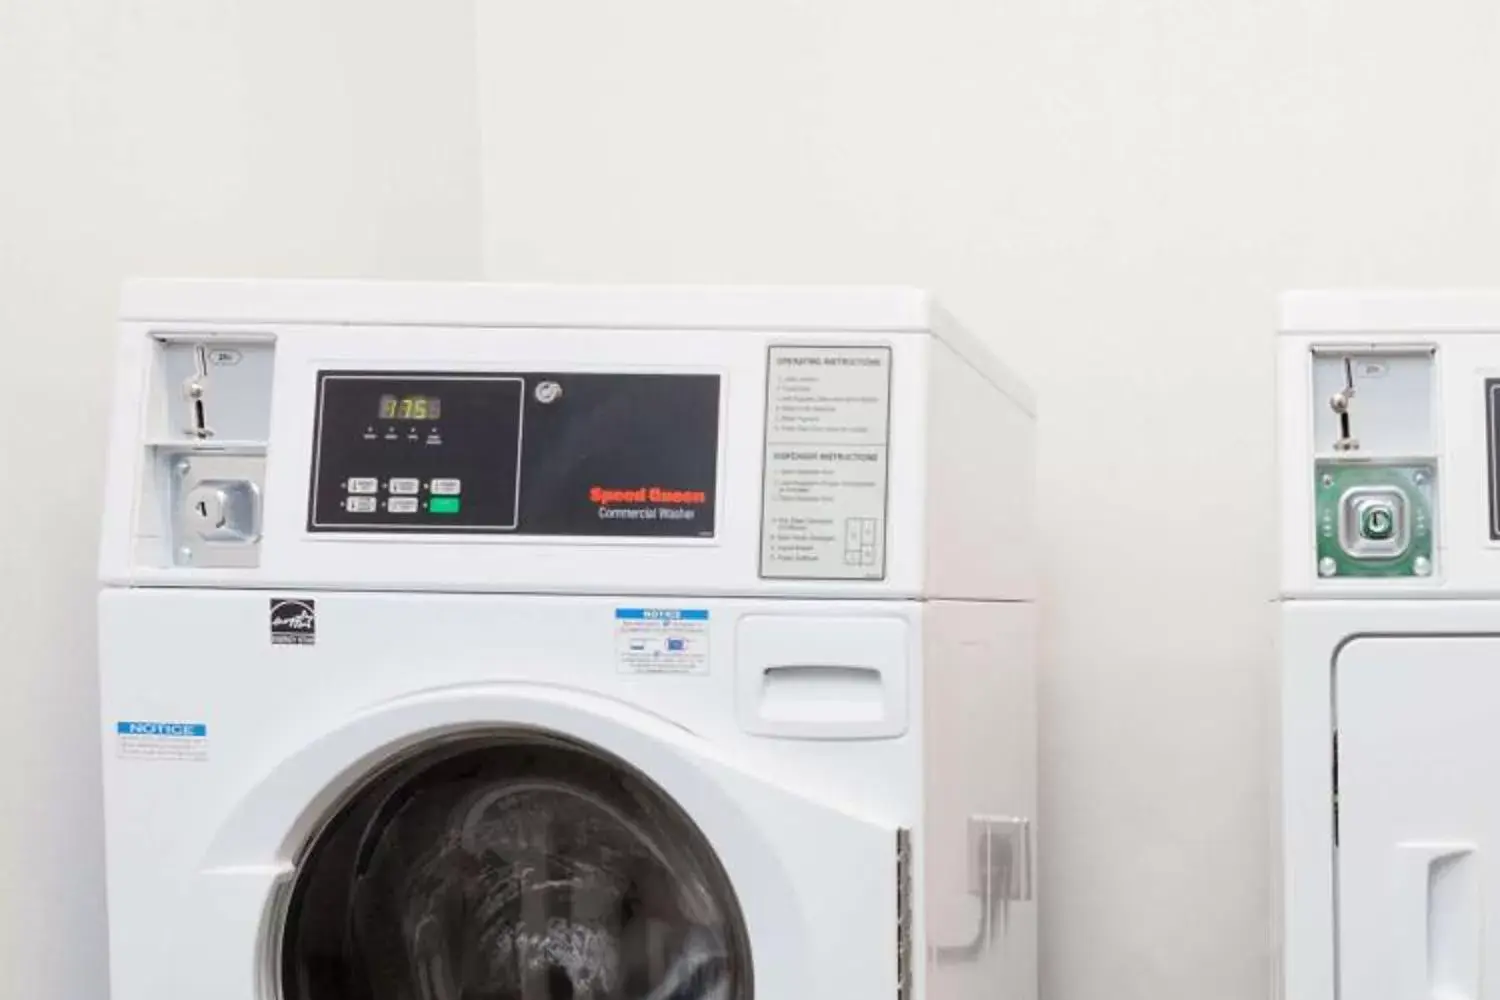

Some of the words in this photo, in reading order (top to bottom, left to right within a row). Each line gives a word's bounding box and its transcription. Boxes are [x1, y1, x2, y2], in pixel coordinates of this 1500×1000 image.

[588, 486, 646, 504] Speed
[648, 487, 705, 503] Queen
[598, 507, 657, 519] Commercial
[659, 508, 695, 519] Washer
[129, 722, 194, 736] NOTICE
